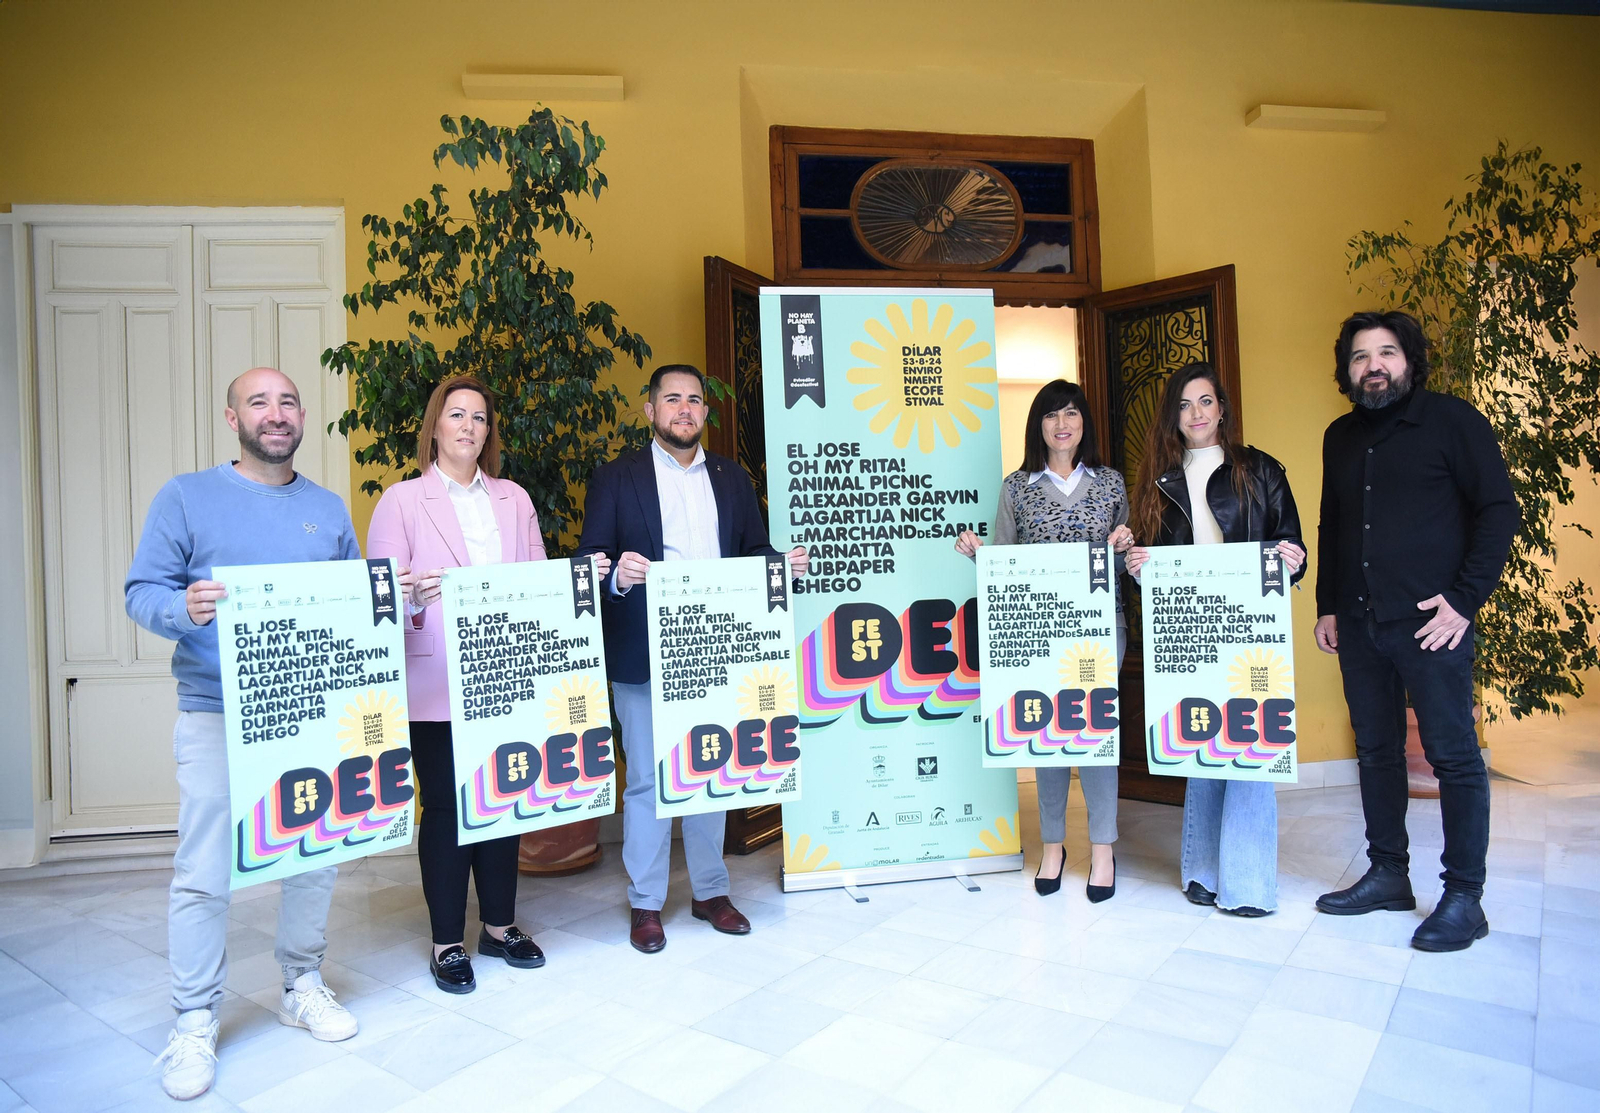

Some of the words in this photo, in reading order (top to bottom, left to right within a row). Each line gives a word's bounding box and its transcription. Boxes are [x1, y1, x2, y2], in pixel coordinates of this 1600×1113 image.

[798, 325, 806, 334] B
[904, 376, 942, 384] NMENT
[904, 386, 943, 395] ECOFE
[905, 397, 944, 406] STIVAL
[787, 444, 808, 458] EL
[813, 443, 860, 457] JOSE
[788, 460, 818, 475] OH
[824, 459, 853, 474] MY
[860, 458, 906, 473] RITA!
[788, 476, 864, 492] ANIMAL
[870, 475, 932, 490] PICNIC
[789, 492, 900, 509] ALEXANDER
[907, 490, 978, 505] GARVIN
[790, 509, 895, 526] LAGARTIJA
[901, 507, 945, 522] NICK
[793, 543, 894, 559] ARNATTA
[808, 559, 895, 576] UBPAPER
[987, 585, 1000, 594] EL
[1002, 584, 1031, 593] JOSE
[1152, 587, 1165, 596] EL
[1167, 586, 1197, 596] JOSE
[987, 594, 1005, 603] OH
[1009, 593, 1027, 602] MY
[1030, 592, 1058, 602] RITA!
[1152, 596, 1171, 606] OH
[1174, 596, 1193, 605] MY
[1196, 595, 1226, 605] RITA!
[659, 606, 673, 617] EL
[675, 604, 706, 616] JOSE
[988, 602, 1033, 612] ANIMAL
[1036, 601, 1074, 611] PICNIC
[1152, 605, 1200, 615] ANIMAL
[1203, 604, 1244, 614] PICNIC
[457, 616, 472, 628] EL
[475, 612, 509, 626] JOSE
[659, 616, 679, 627] OH
[683, 615, 702, 626] MY
[705, 612, 735, 624] RITA!
[988, 611, 1054, 622] ALEXANDER
[1058, 609, 1102, 619] GARVIN
[1153, 615, 1223, 625] ALEXANDER
[1226, 614, 1276, 624] GARVIN
[234, 623, 252, 636] EL
[257, 618, 297, 633] JOSE
[458, 627, 480, 640] OH
[484, 624, 504, 637] MY
[508, 620, 540, 634] RITA!
[659, 625, 709, 638] ANIMAL
[712, 621, 752, 634] PICNIC
[851, 619, 881, 640] FE
[989, 620, 1051, 631] LAGARTIJA
[1054, 619, 1082, 629] NICK
[1153, 625, 1219, 635] LAGARTIJA
[1222, 624, 1253, 634] NICK
[235, 635, 261, 649] OH
[267, 632, 291, 646] MY
[296, 627, 333, 643] RITA!
[459, 635, 513, 652] ANIMAL
[516, 629, 559, 645] PICNIC
[660, 634, 732, 649] ALEXANDER
[735, 630, 781, 643] GARVIN
[989, 639, 1050, 649] GARNATTA
[236, 645, 301, 663] ANIMAL
[305, 638, 354, 655] PICNIC
[460, 643, 538, 663] ALEXANDER
[541, 636, 589, 652] GARVIN
[661, 645, 728, 659] LAGARTIJA
[731, 642, 760, 654] NICK
[851, 640, 883, 662] ST
[989, 648, 1050, 659] DUBPAPER
[1154, 644, 1218, 654] GARNATTA
[237, 654, 330, 677] ALEXANDER
[334, 646, 389, 664] GARVIN
[461, 655, 534, 675] LAGARTIJA
[537, 650, 569, 664] NICK
[990, 658, 1030, 668] SHEGO
[1154, 654, 1218, 664] DUBPAPER
[238, 668, 325, 690] LAGARTIJA
[329, 662, 364, 678] NICK
[662, 666, 728, 681] GARNATTA
[1154, 664, 1197, 673] SHEGO
[462, 678, 535, 698] GARNATTA
[662, 676, 728, 691] DUBPAPER
[463, 689, 535, 710] DUBPAPER
[663, 688, 707, 702] SHEGO
[241, 694, 325, 717] GARNATTA
[464, 704, 512, 721] SHEGO
[1015, 687, 1120, 731] DEE
[1024, 699, 1041, 711] FE
[241, 707, 326, 731] DUBPAPER
[1024, 710, 1042, 723] ST
[1181, 697, 1296, 743] DEE
[1190, 707, 1209, 720] FE
[1190, 719, 1210, 732] ST
[242, 724, 299, 745] SHEGO
[365, 733, 384, 741] ECOFE
[701, 734, 720, 747] FE
[691, 715, 800, 772] DEE
[496, 726, 615, 794] DEE
[508, 751, 528, 768] FE
[701, 746, 721, 761] ST
[508, 765, 529, 782] ST
[280, 747, 415, 829] DEE
[294, 778, 317, 798] FE
[294, 794, 319, 814] ST
[899, 814, 920, 822] RIVES
[383, 831, 407, 842] ERMITA
